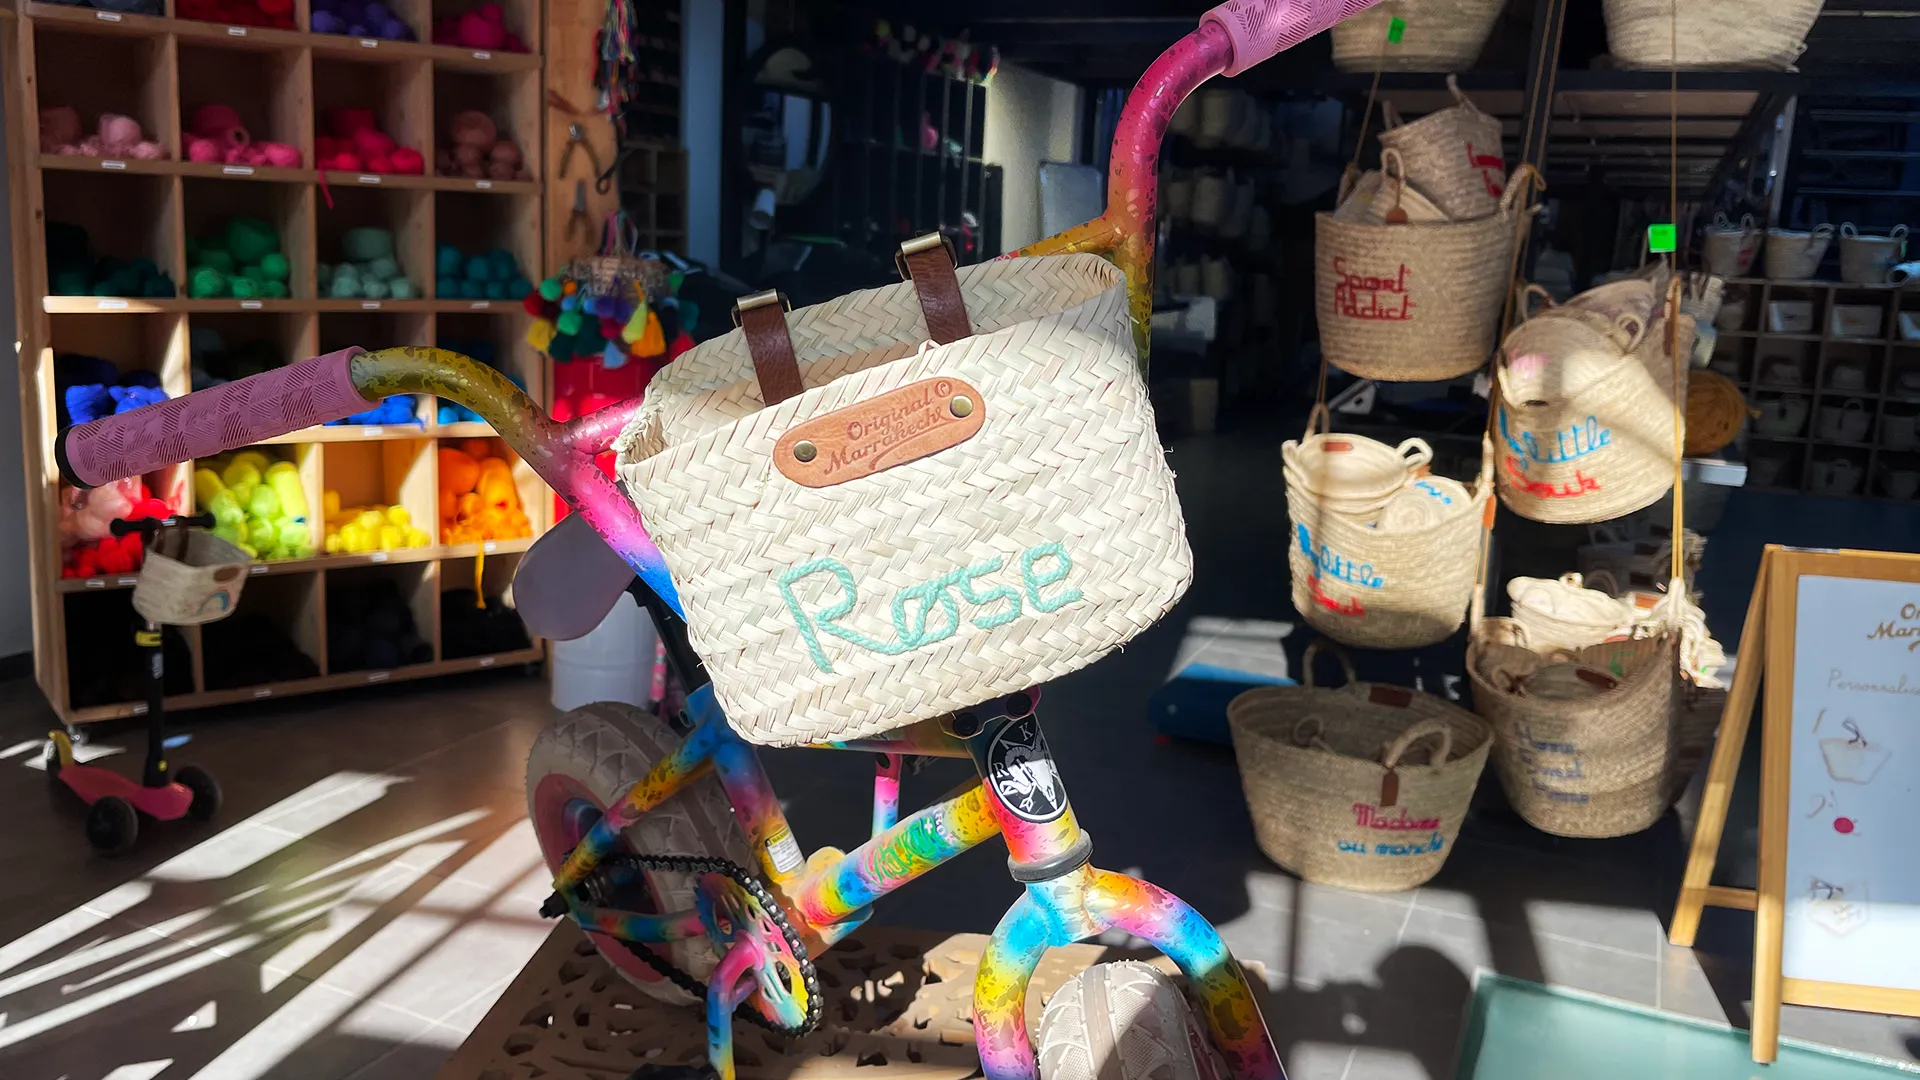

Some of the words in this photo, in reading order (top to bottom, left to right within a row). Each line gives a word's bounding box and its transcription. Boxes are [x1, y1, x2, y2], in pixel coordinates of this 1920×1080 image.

[847, 387, 933, 440] Original
[823, 406, 944, 475] Marrakech
[777, 541, 1084, 674] Rose
[1019, 721, 1034, 741] K
[993, 761, 1010, 778] R
